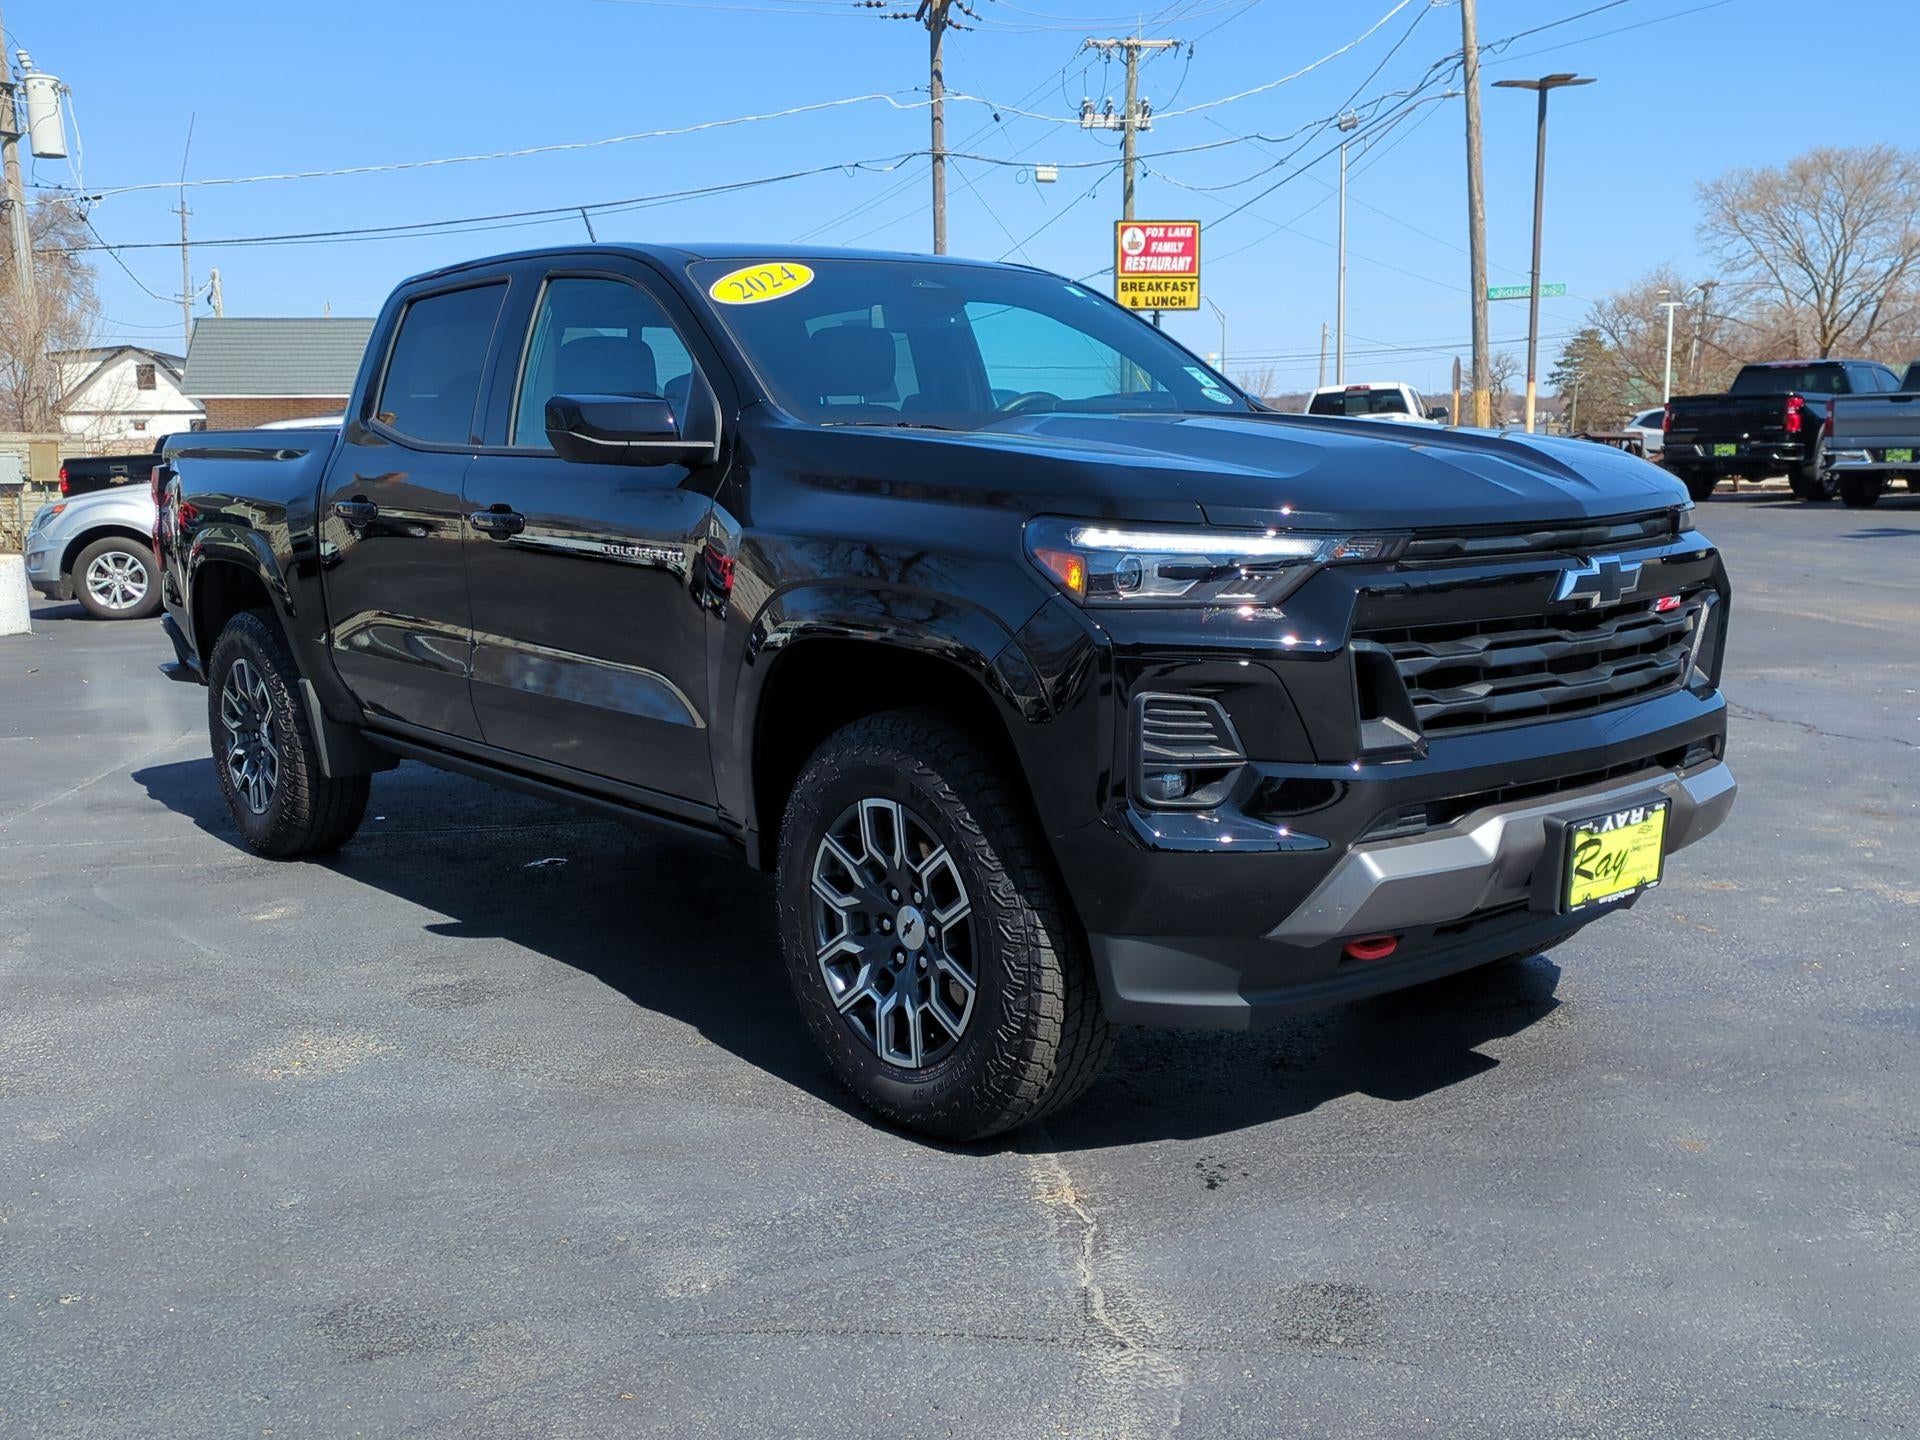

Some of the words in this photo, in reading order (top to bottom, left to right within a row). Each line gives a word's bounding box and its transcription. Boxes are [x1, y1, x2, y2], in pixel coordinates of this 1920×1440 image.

[1145, 227, 1165, 237] FOX
[1167, 227, 1193, 237] LAKE
[1150, 241, 1184, 253] FAMILY
[1124, 256, 1192, 272] RESTAURANT
[729, 265, 797, 299] 2024
[1121, 281, 1196, 292] BREAKFAST
[1130, 296, 1139, 306] &
[1145, 296, 1186, 306] LUNCH
[601, 544, 683, 561] COLORADO
[1574, 838, 1629, 886] Ray
